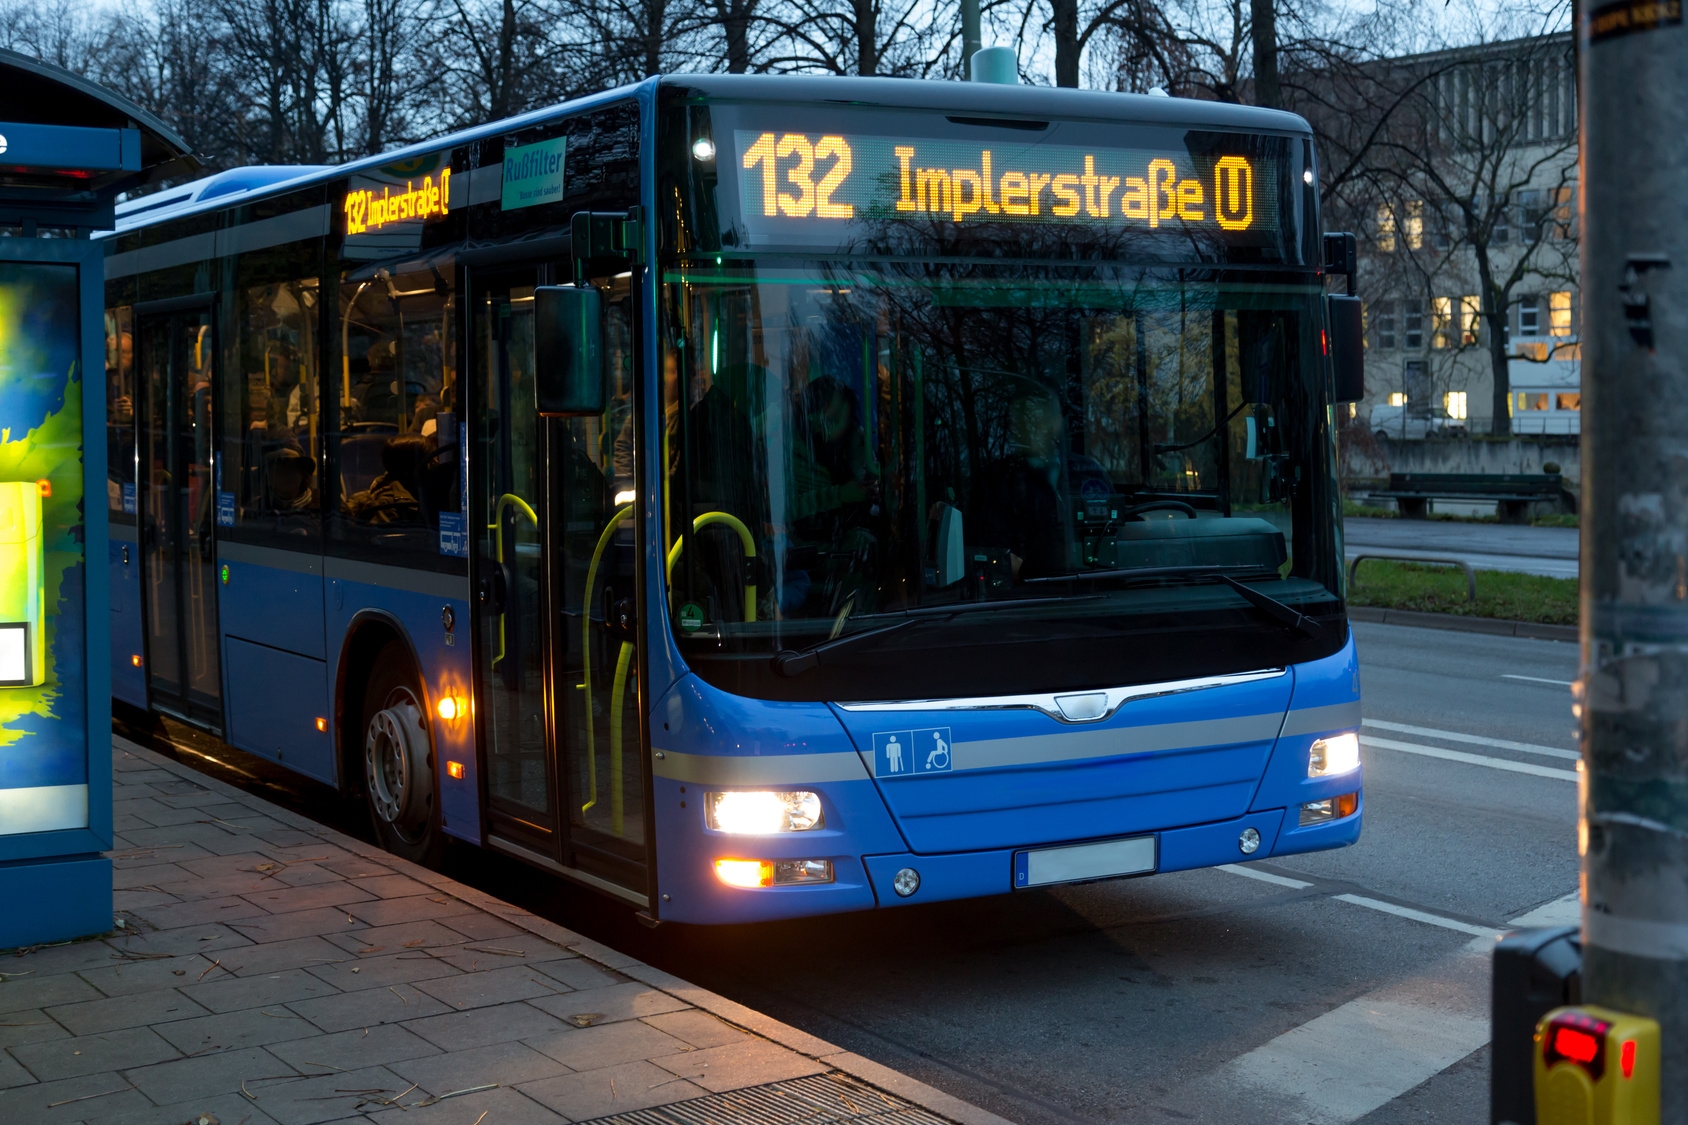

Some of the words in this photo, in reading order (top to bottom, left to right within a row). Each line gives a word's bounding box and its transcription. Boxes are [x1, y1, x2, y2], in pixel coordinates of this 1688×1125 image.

[505, 149, 563, 183] Rußfilter
[744, 133, 853, 219] 132
[895, 147, 1204, 228] Implerstraße
[345, 190, 366, 235] 132
[367, 176, 440, 229] Implerstraße
[687, 605, 695, 618] 4
[1018, 872, 1025, 881] D
